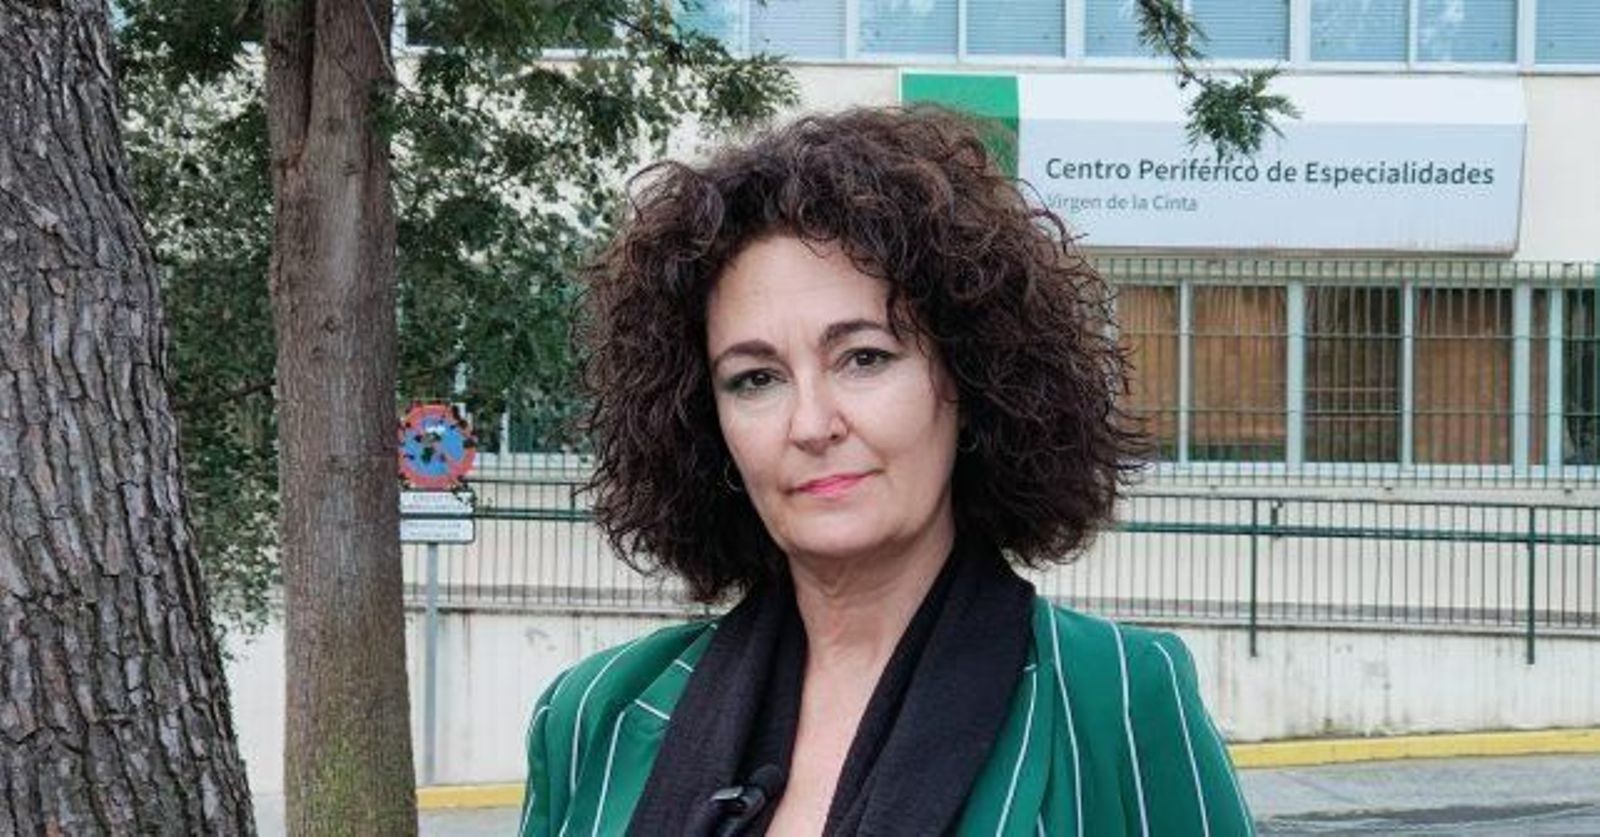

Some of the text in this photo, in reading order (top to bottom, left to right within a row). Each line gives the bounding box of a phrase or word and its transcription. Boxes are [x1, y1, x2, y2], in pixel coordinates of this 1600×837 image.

[1046, 157, 1495, 188] Centro Periférico de Especialidades
[1047, 193, 1198, 213] Virgen de la Cinta
